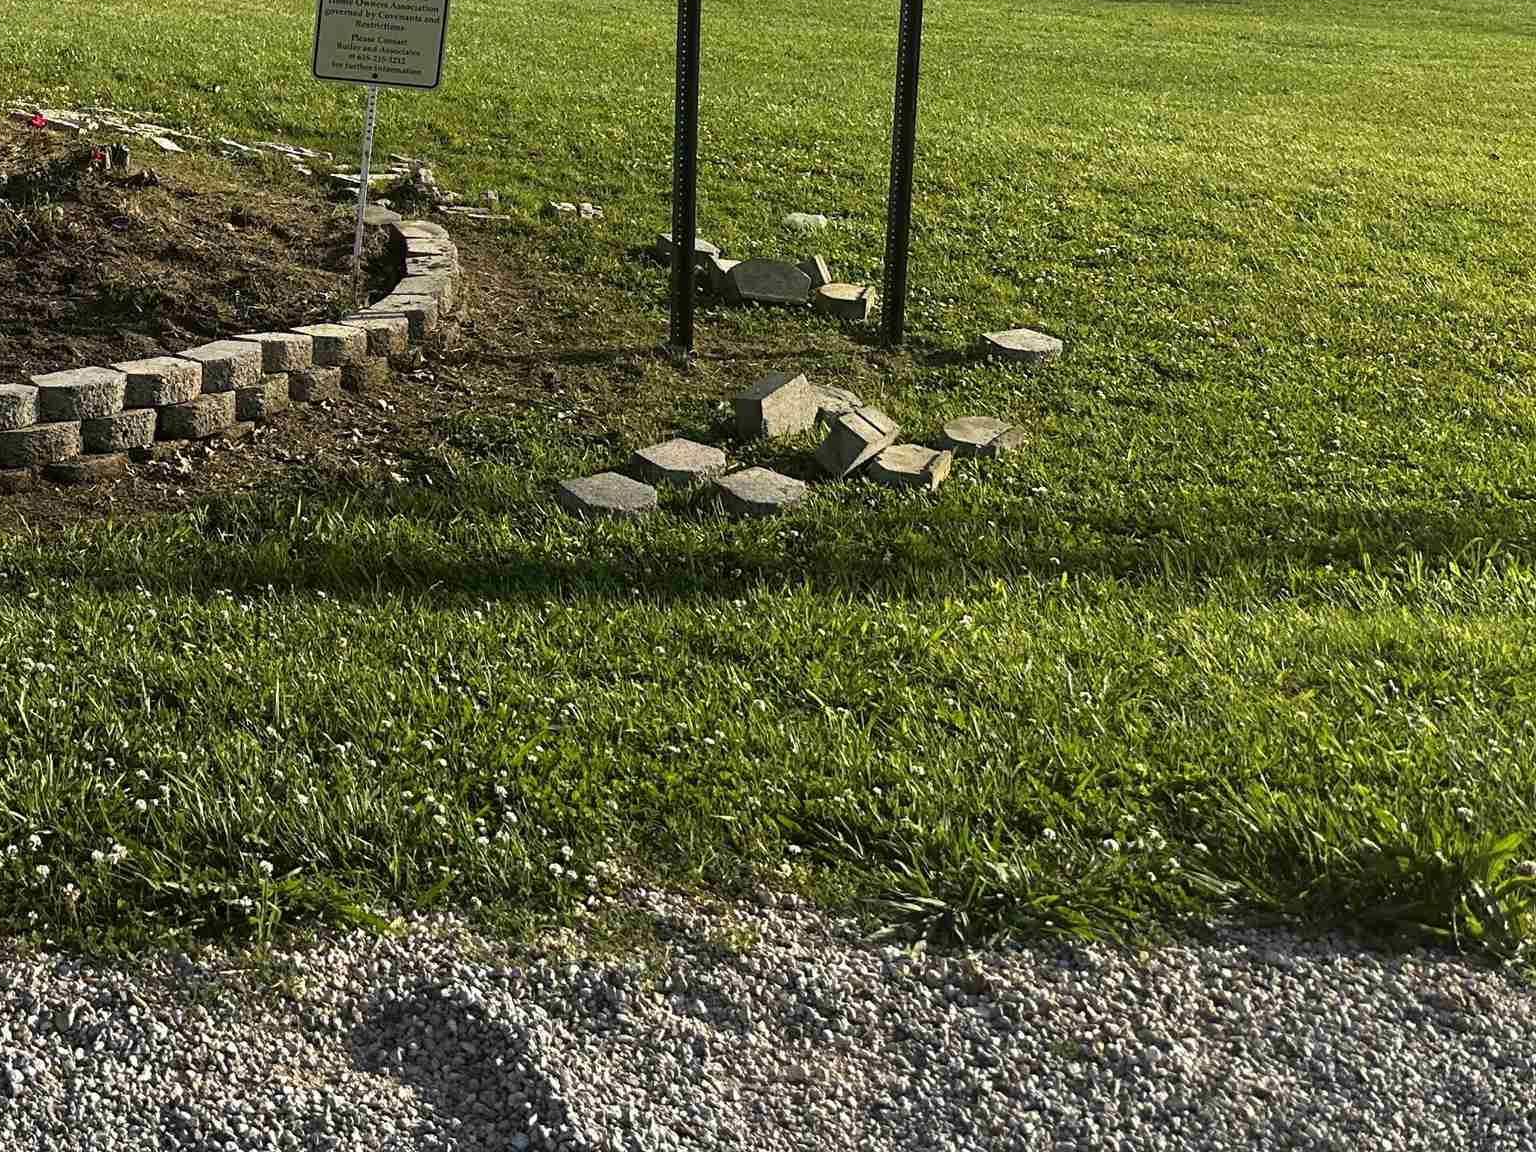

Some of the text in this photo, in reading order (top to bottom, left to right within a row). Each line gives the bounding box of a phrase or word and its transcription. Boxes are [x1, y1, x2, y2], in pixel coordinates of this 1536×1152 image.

[356, 0, 388, 9] Owners
[390, 2, 439, 12] Association
[325, 8, 440, 24] governed by Covenants and
[352, 34, 408, 45] Please Contact
[362, 43, 377, 52] and
